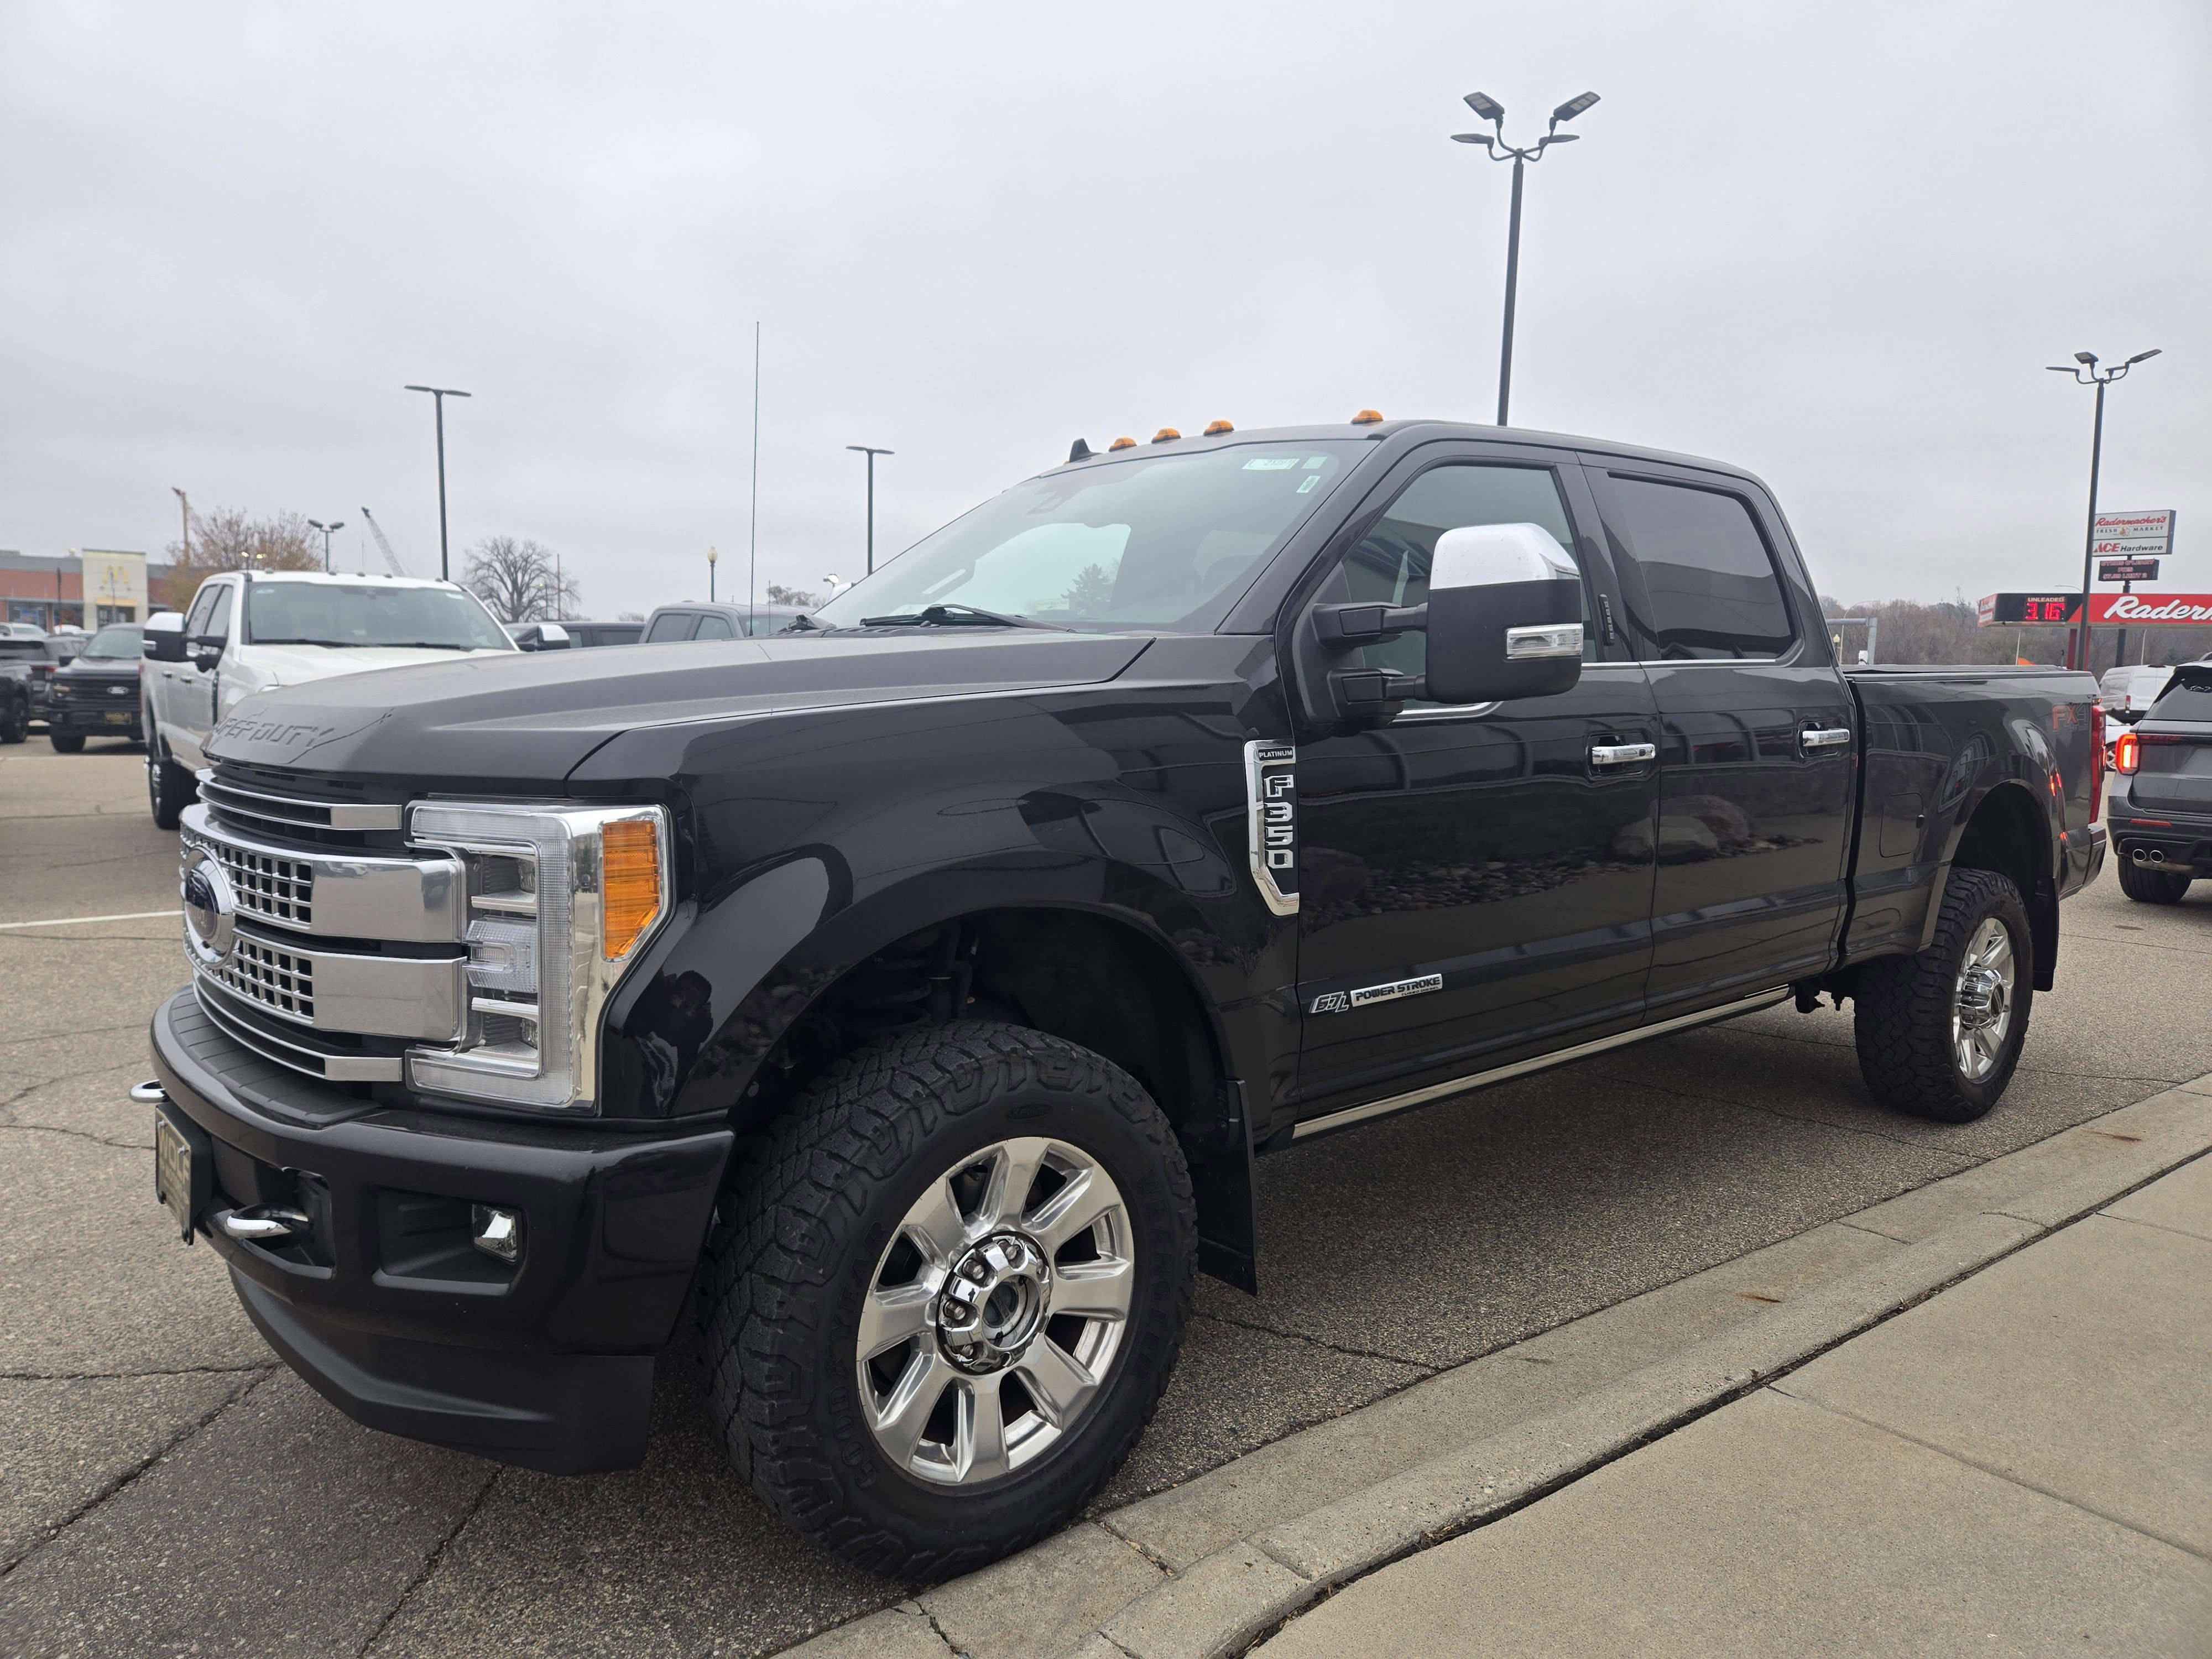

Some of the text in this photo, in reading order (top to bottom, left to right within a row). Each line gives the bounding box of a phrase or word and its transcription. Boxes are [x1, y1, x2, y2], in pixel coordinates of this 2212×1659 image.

[2095, 516, 2167, 526] Radermacher's
[2094, 542, 2121, 552] ACE
[2104, 596, 2212, 620] Rader
[2052, 702, 2089, 732] FX4
[248, 723, 335, 748] DUTY
[1259, 749, 1293, 758] PLATINUM
[1264, 774, 1294, 869] F350
[1355, 985, 1395, 1001] POWER
[1397, 977, 1440, 993] STROKE
[1130, 1167, 1173, 1382] WRANGLER
[825, 1220, 887, 1490] GOODYEAR
